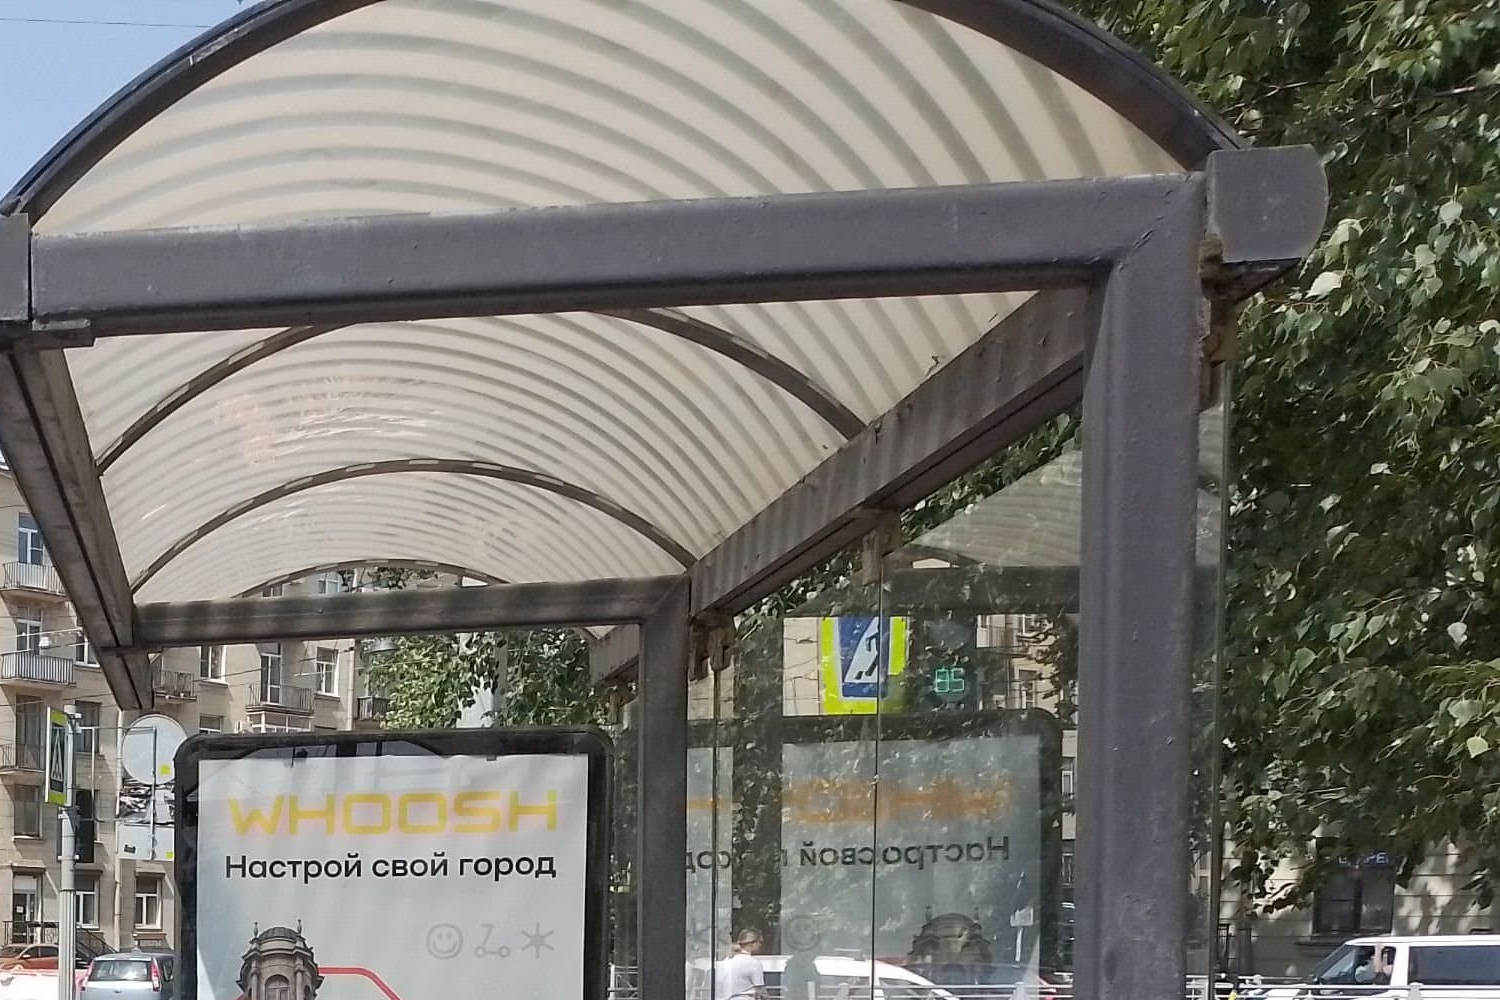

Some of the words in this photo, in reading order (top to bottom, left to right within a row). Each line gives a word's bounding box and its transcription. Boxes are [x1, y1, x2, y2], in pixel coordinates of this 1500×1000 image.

[228, 789, 558, 836] WHOOSH
[225, 853, 362, 884] Настрой
[371, 851, 449, 878] свой
[458, 855, 557, 882] город
